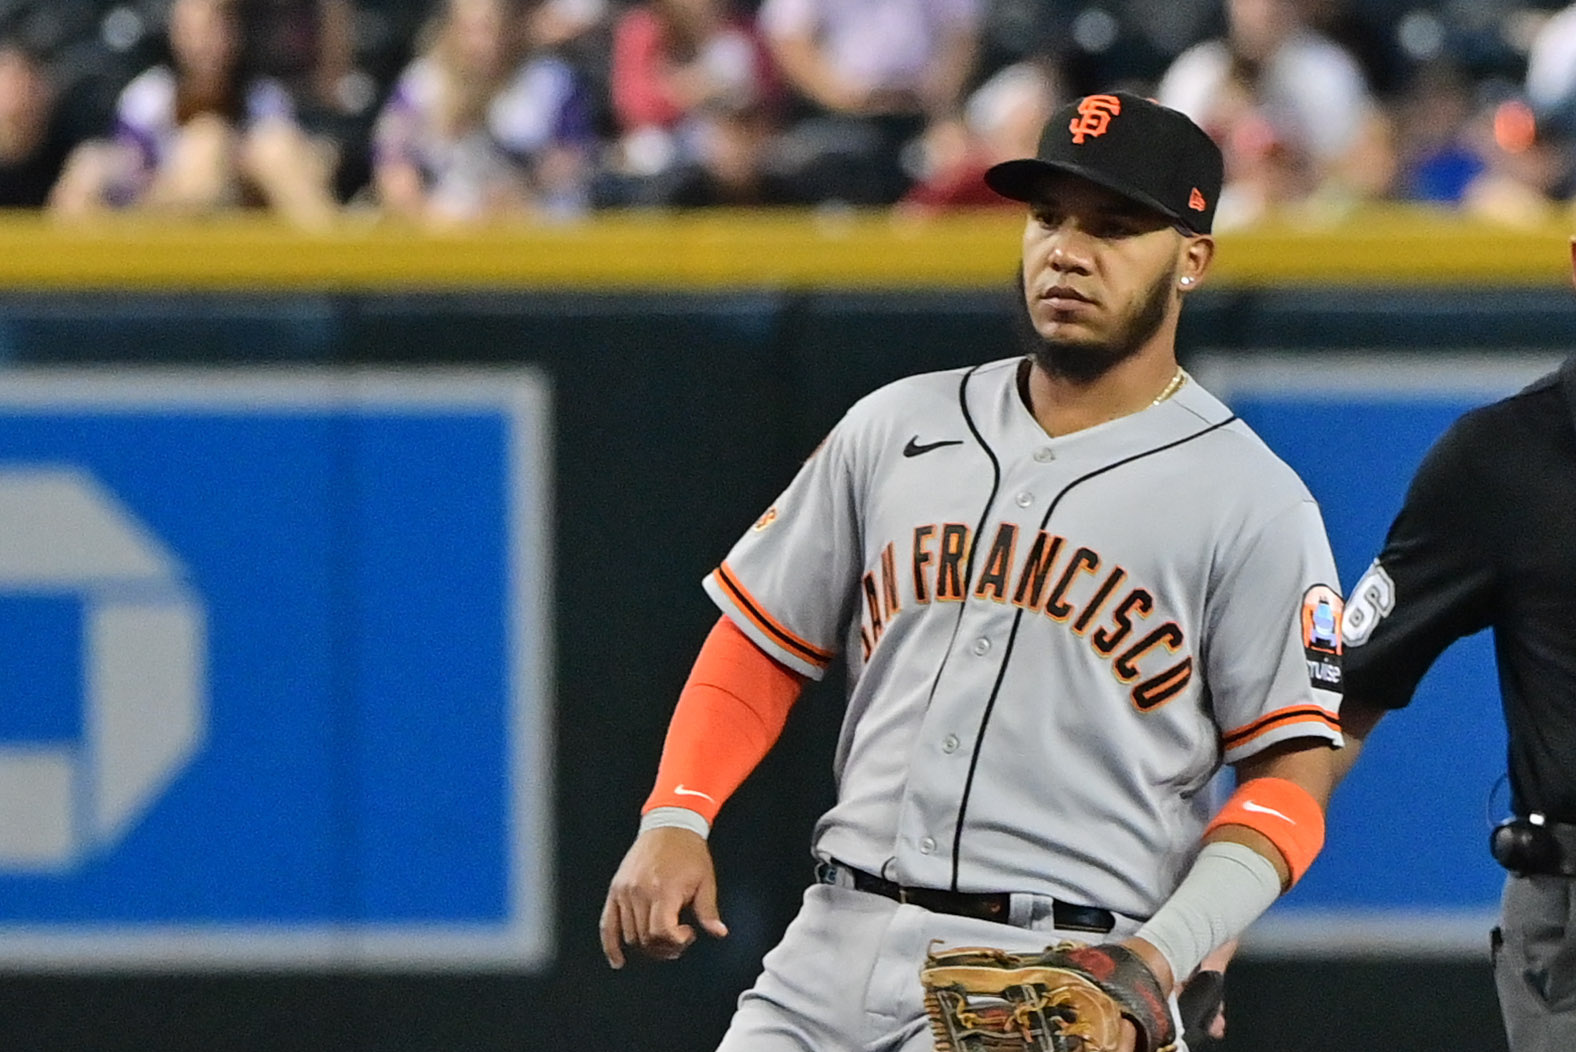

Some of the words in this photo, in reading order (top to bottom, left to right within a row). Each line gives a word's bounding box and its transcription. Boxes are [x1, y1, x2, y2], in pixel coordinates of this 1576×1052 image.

[1069, 94, 1122, 145] SF
[911, 522, 1193, 714] FRANCISCO
[1306, 657, 1341, 683] ruise
